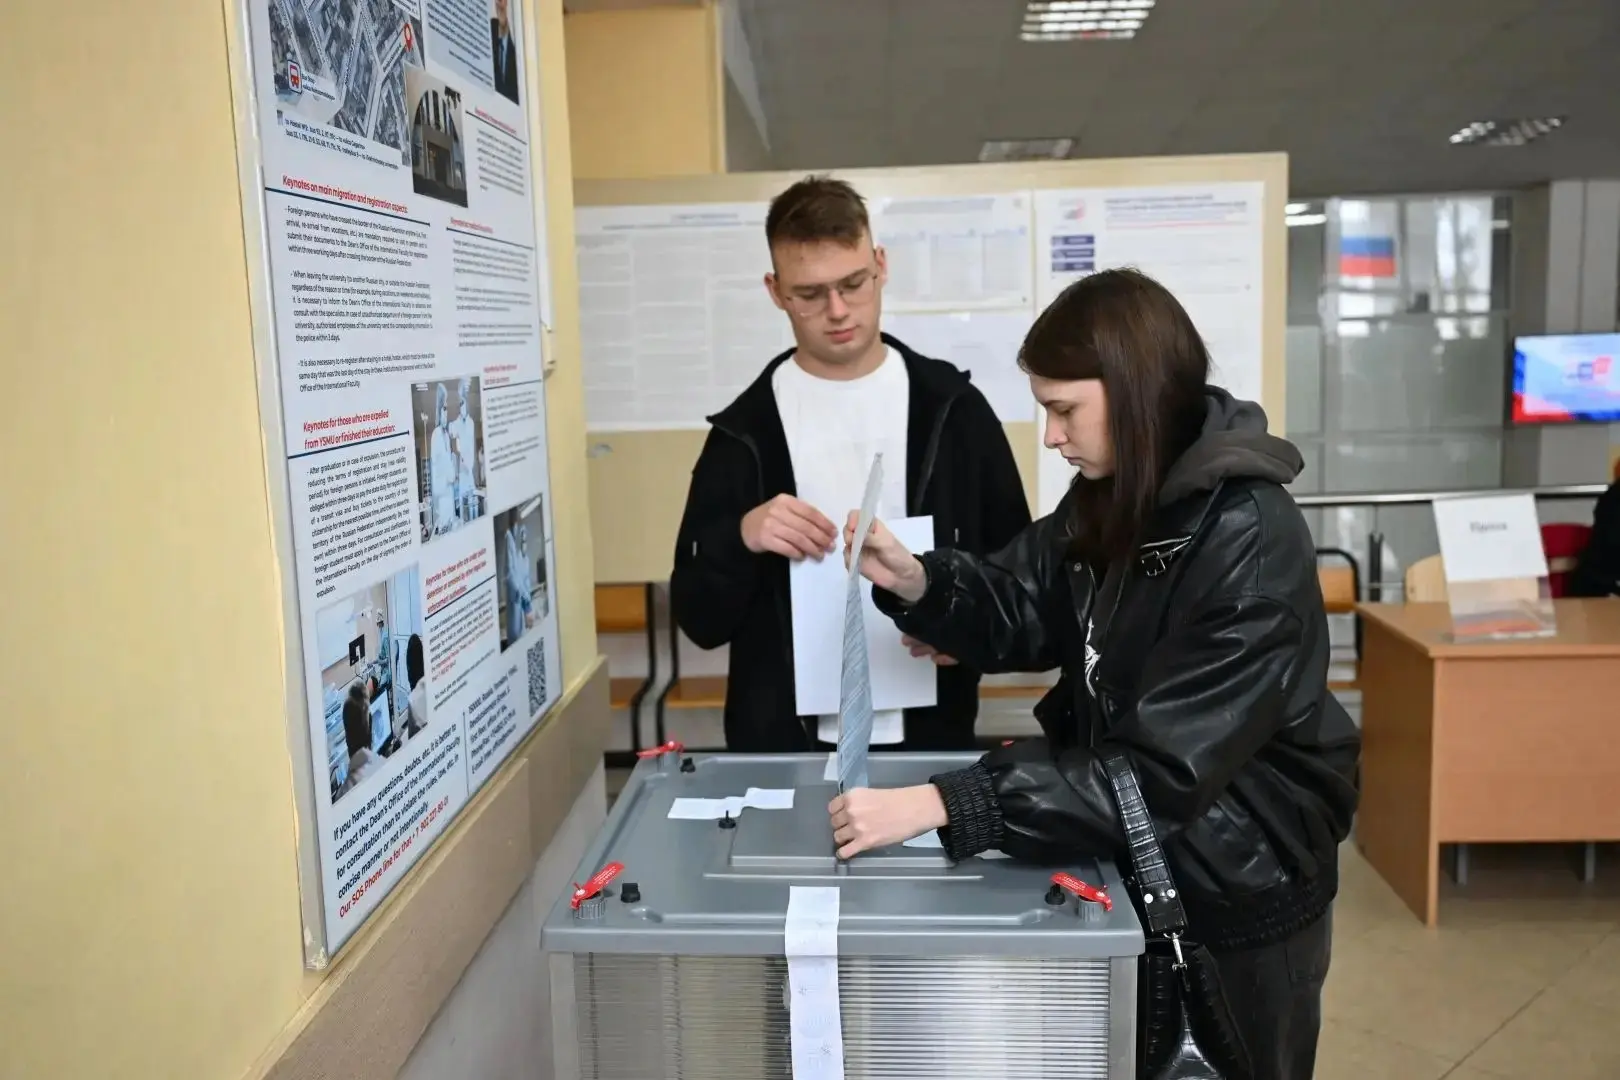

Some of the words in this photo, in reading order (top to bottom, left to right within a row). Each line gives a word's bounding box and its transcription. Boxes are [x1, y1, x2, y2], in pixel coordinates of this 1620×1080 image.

[283, 176, 310, 190] Keynotes
[310, 184, 318, 192] on
[318, 185, 332, 195] main
[333, 188, 357, 201] migration
[358, 195, 366, 203] and
[366, 197, 391, 209] registration
[304, 421, 329, 433] Keynotes
[338, 417, 351, 426] those
[352, 414, 362, 424] who
[371, 410, 389, 421] expelled
[305, 440, 319, 449] from
[320, 435, 335, 446] YSMU
[341, 430, 361, 442] finished
[361, 427, 373, 438] their
[373, 424, 396, 436] education:
[334, 827, 339, 840] If
[339, 820, 351, 839] you
[352, 806, 366, 824] have
[367, 797, 377, 811] any
[439, 728, 452, 744] better
[452, 724, 457, 732] to
[336, 832, 358, 860] contact
[359, 824, 369, 837] the
[370, 805, 388, 827] Dean's
[388, 791, 404, 809] Office
[404, 782, 410, 794] of
[410, 777, 418, 789] the
[419, 748, 446, 780] International
[446, 736, 461, 753] Faculty
[337, 865, 346, 880] for
[346, 831, 382, 869] consultation
[382, 818, 394, 834] than
[395, 812, 401, 822] to
[401, 795, 417, 815] violate
[338, 871, 360, 898] concise
[361, 848, 383, 875] manner
[384, 841, 389, 852] or
[390, 831, 399, 845] not
[340, 901, 351, 917] Our
[352, 886, 364, 905] SOS
[365, 868, 382, 891] Phone
[383, 857, 393, 872] line
[401, 836, 412, 852] that
